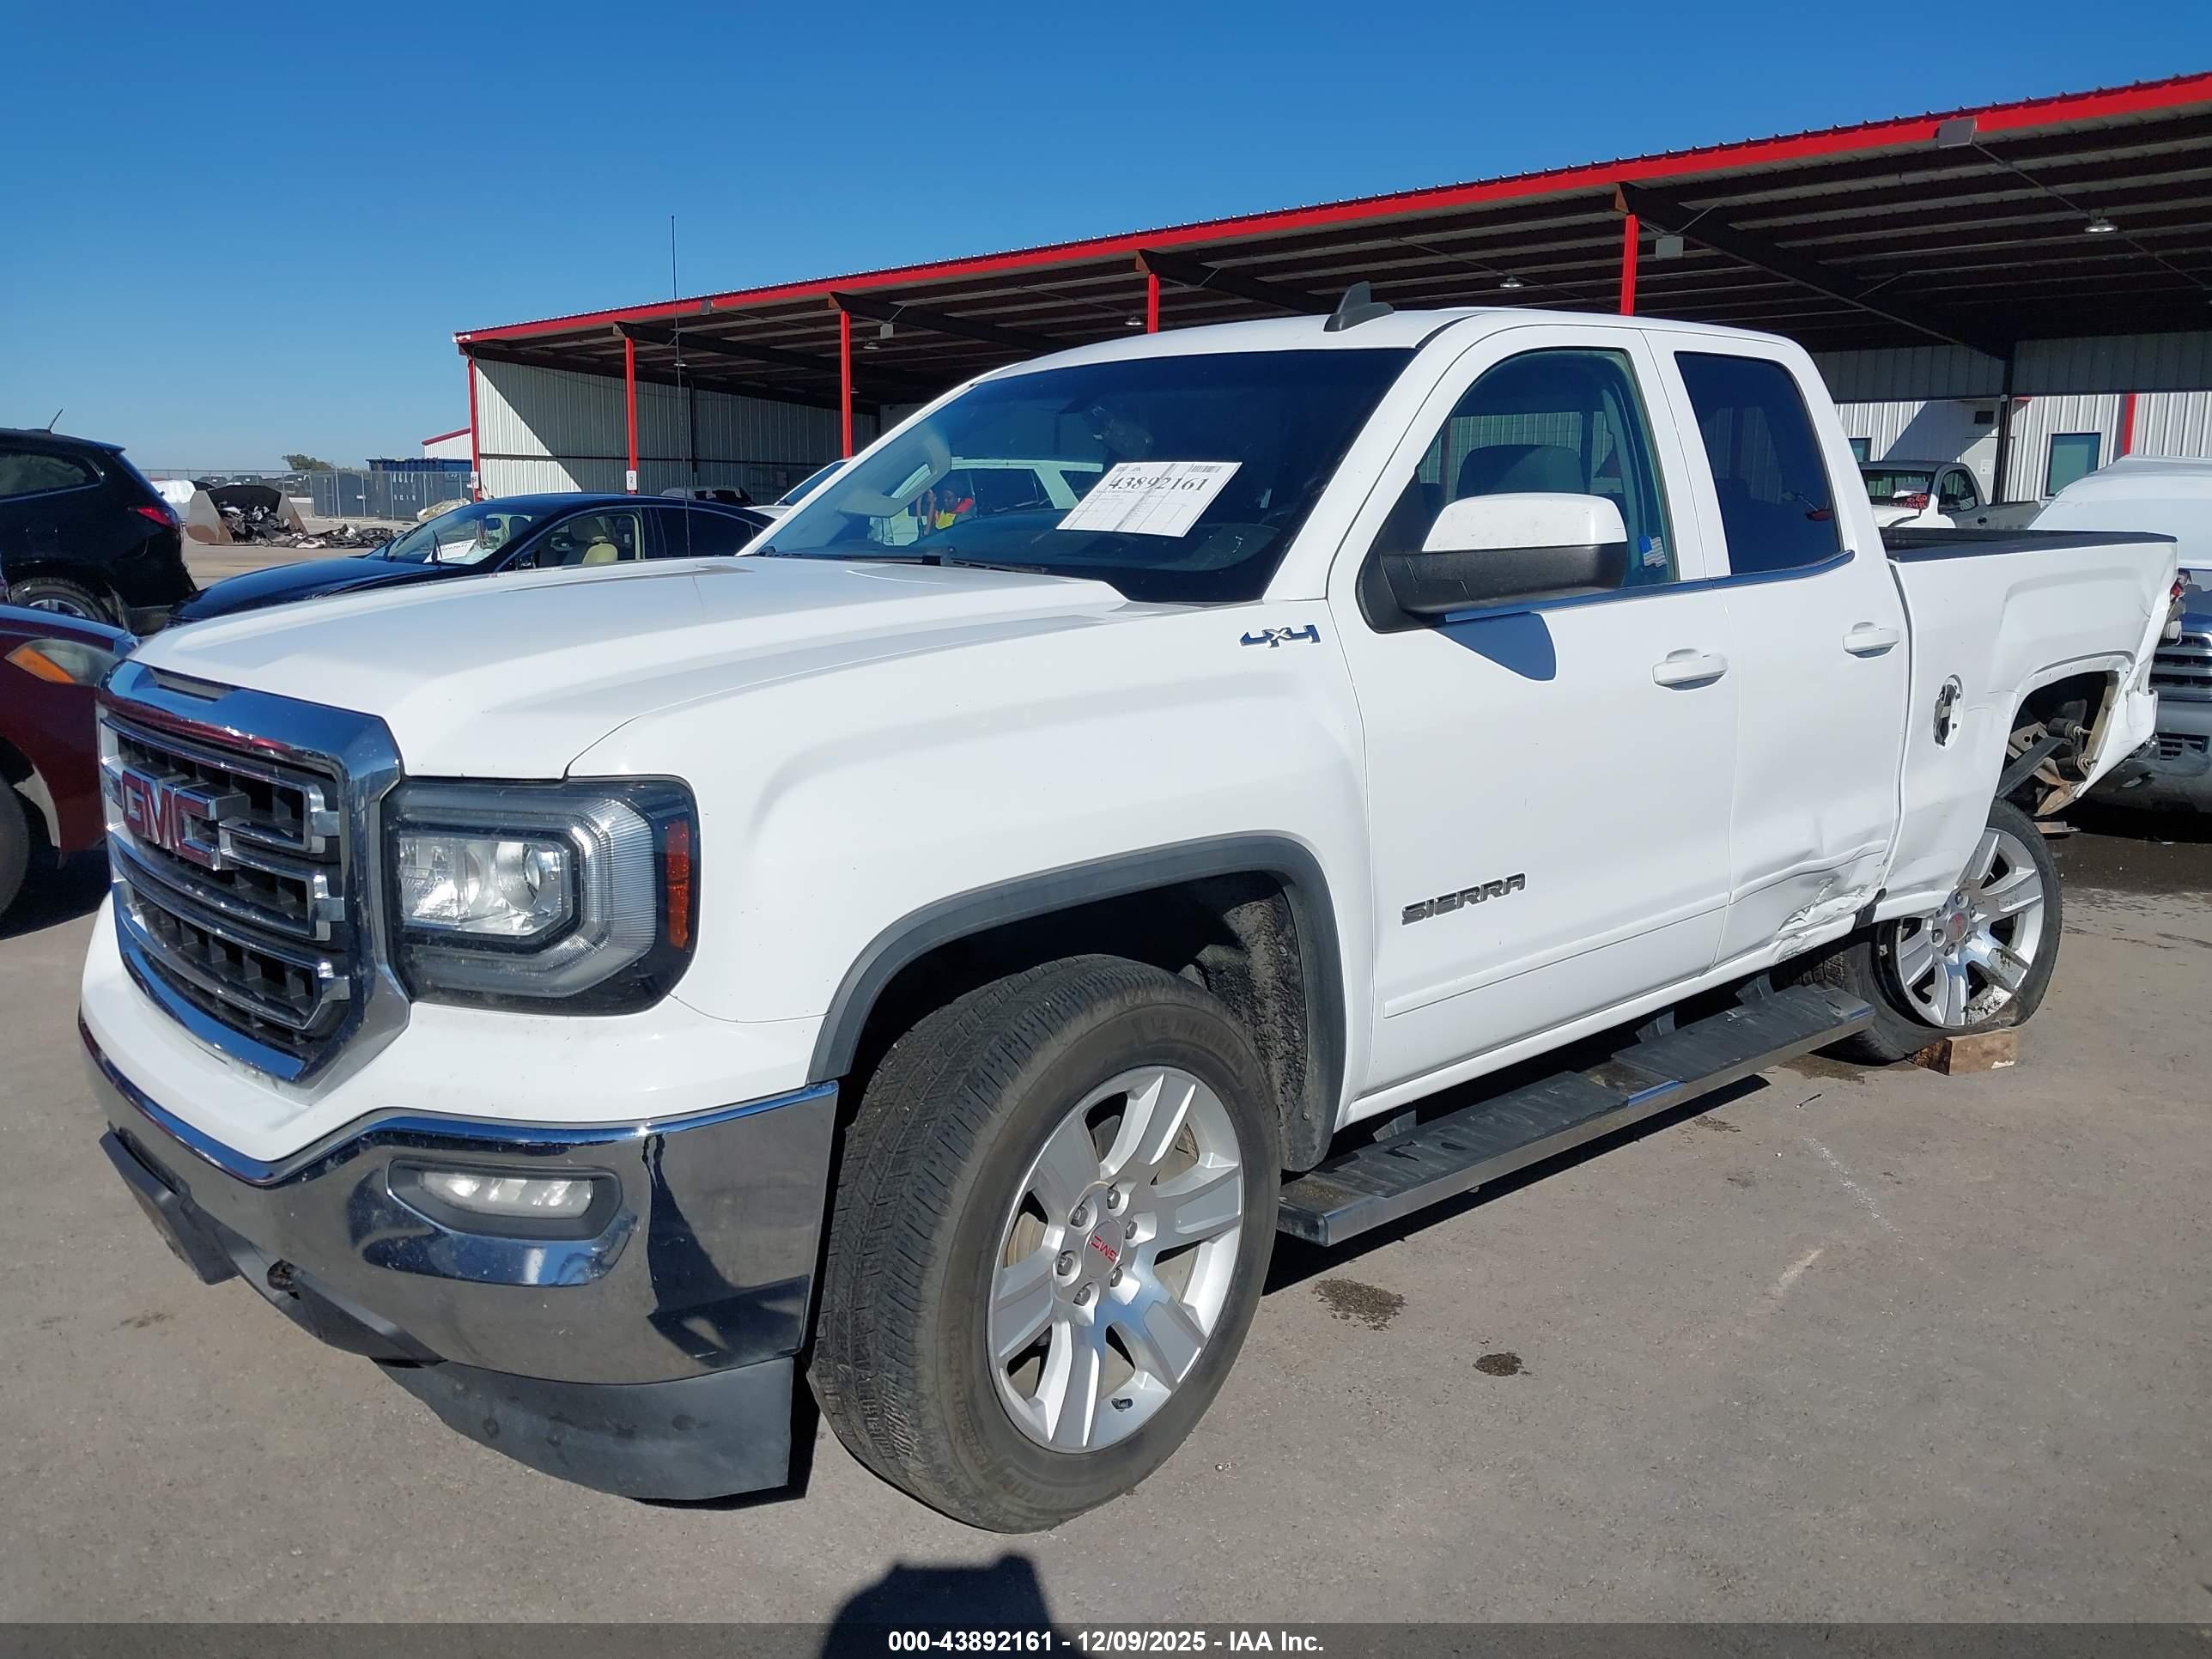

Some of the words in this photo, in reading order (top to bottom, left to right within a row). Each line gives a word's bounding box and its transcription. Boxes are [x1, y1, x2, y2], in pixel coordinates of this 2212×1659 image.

[1109, 477, 1210, 491] 43892161
[122, 769, 221, 869] GMC
[1401, 872, 1526, 926] SIERRA
[1091, 1235, 1117, 1263] GMC
